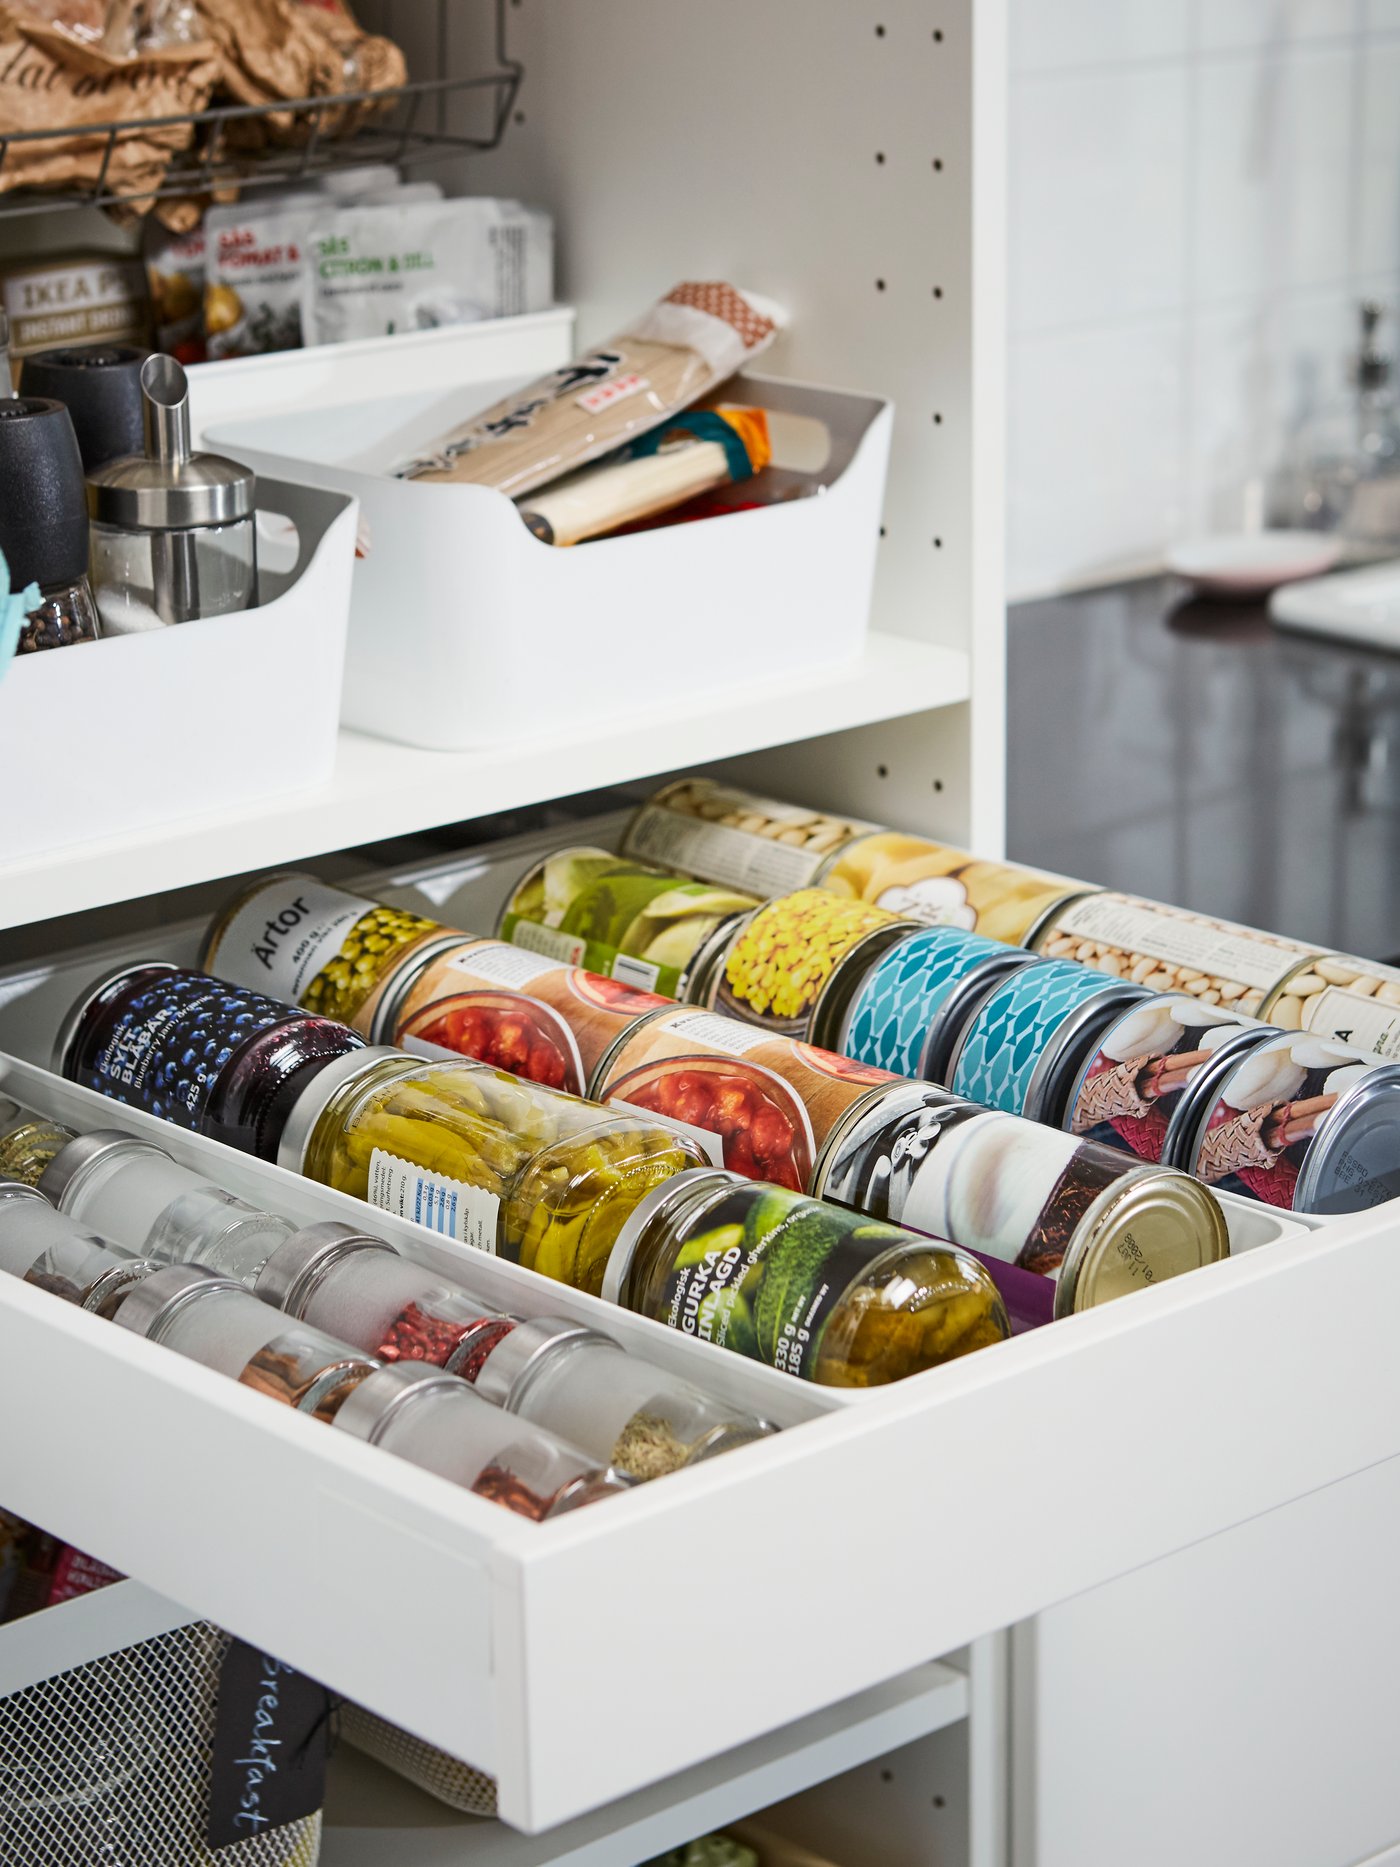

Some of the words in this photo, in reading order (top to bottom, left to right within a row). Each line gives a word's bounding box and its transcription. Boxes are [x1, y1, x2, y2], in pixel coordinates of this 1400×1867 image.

[22, 276, 91, 309] IKEA
[250, 897, 310, 970] Ärtor
[100, 1023, 127, 1074] Ekologisk
[110, 1028, 137, 1080] SYLT
[120, 1009, 173, 1085] BLÅBÄR
[134, 1038, 162, 1089] Blueberry
[185, 1084, 201, 1111] 425
[197, 1072, 207, 1084] g
[668, 1267, 691, 1328] Ekologisk
[682, 1251, 722, 1334] GURKA
[698, 1246, 741, 1341] INLAGD
[716, 1309, 731, 1347] Sliced
[726, 1263, 750, 1309] pickled
[747, 1223, 789, 1264] gherkins,
[774, 1337, 790, 1371] 330
[784, 1322, 797, 1337] g
[788, 1342, 803, 1376] 185
[797, 1327, 810, 1342] g
[233, 1657, 295, 1832] Breakfast
